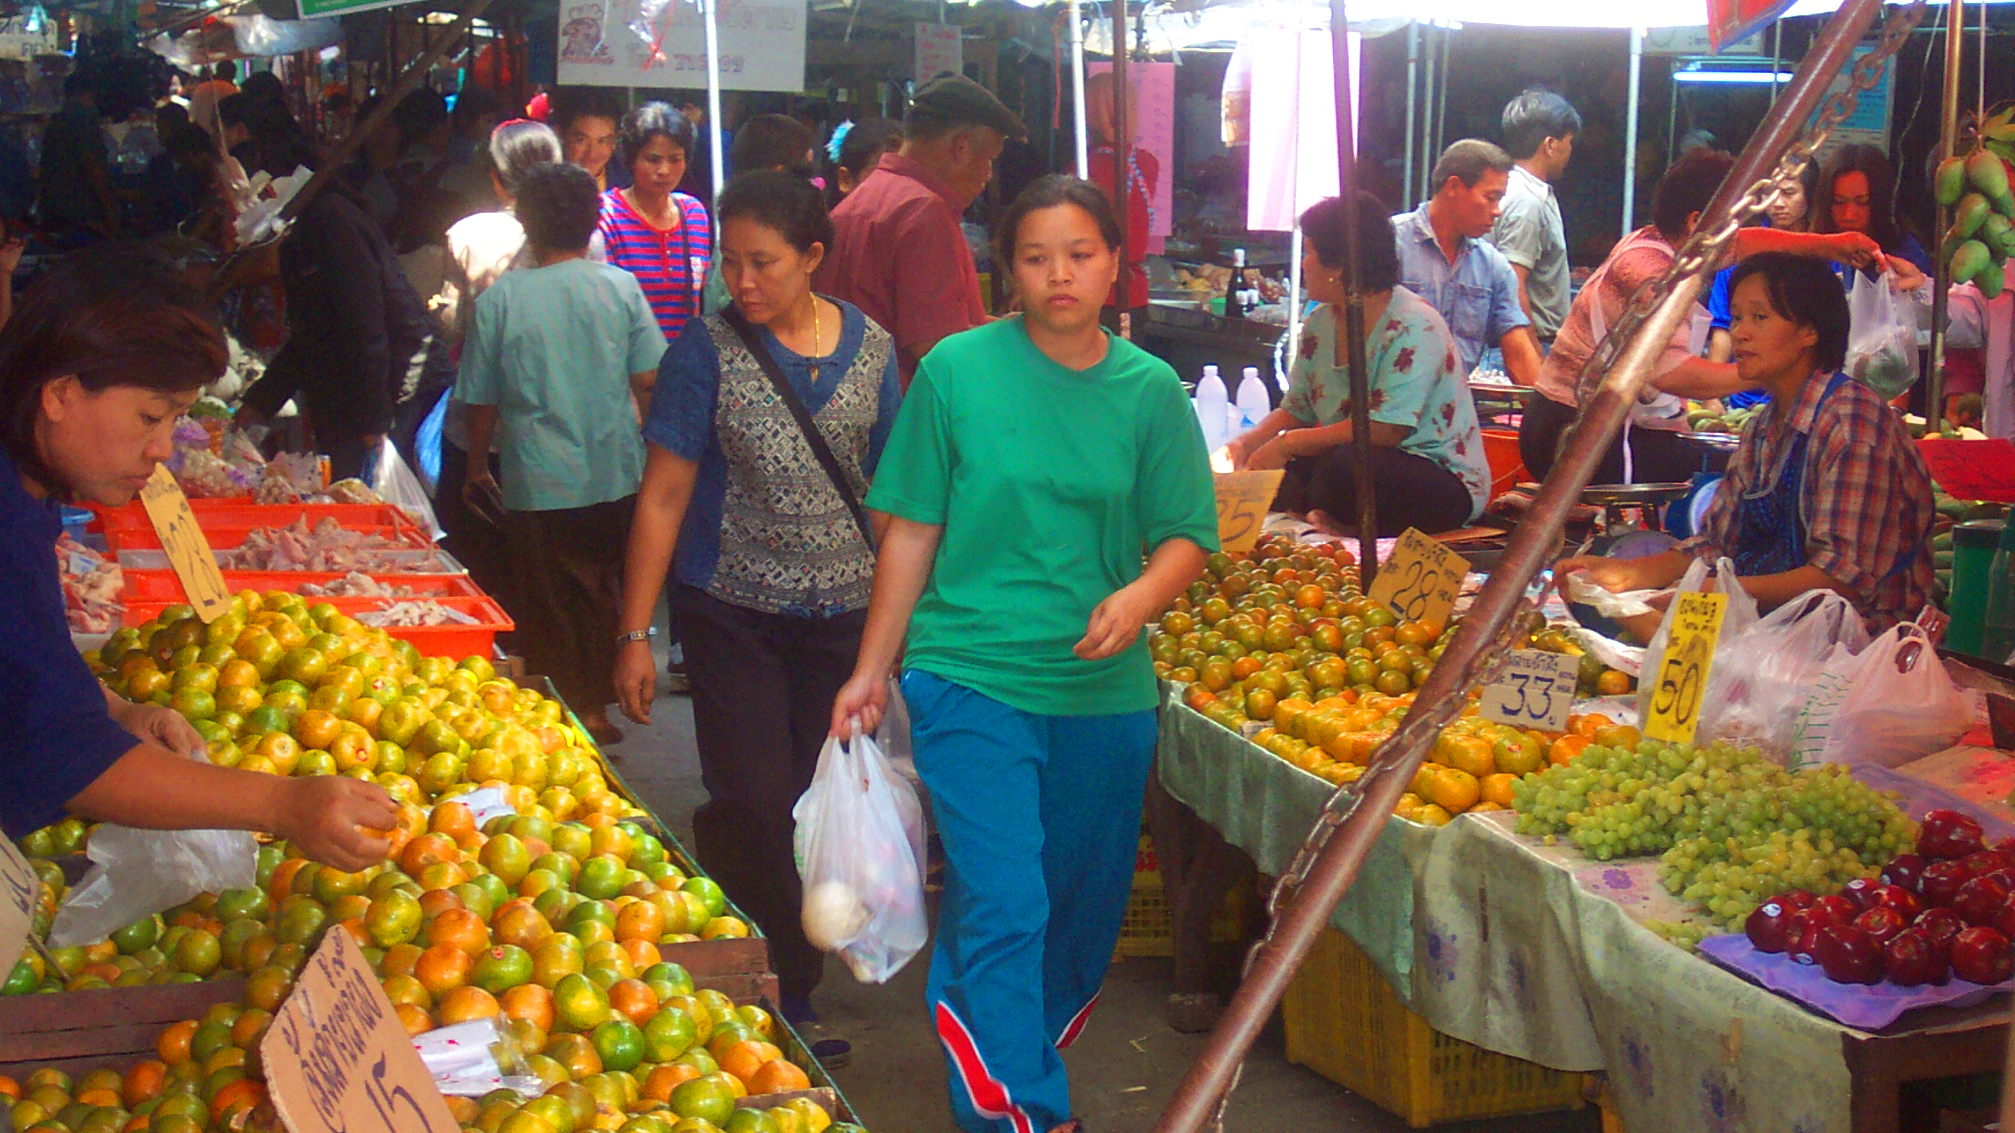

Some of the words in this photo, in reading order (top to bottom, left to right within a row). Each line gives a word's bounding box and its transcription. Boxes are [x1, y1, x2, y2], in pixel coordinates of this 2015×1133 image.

[1390, 560, 1439, 621] 28
[1501, 672, 1555, 720] 33
[1655, 658, 1699, 725] 50
